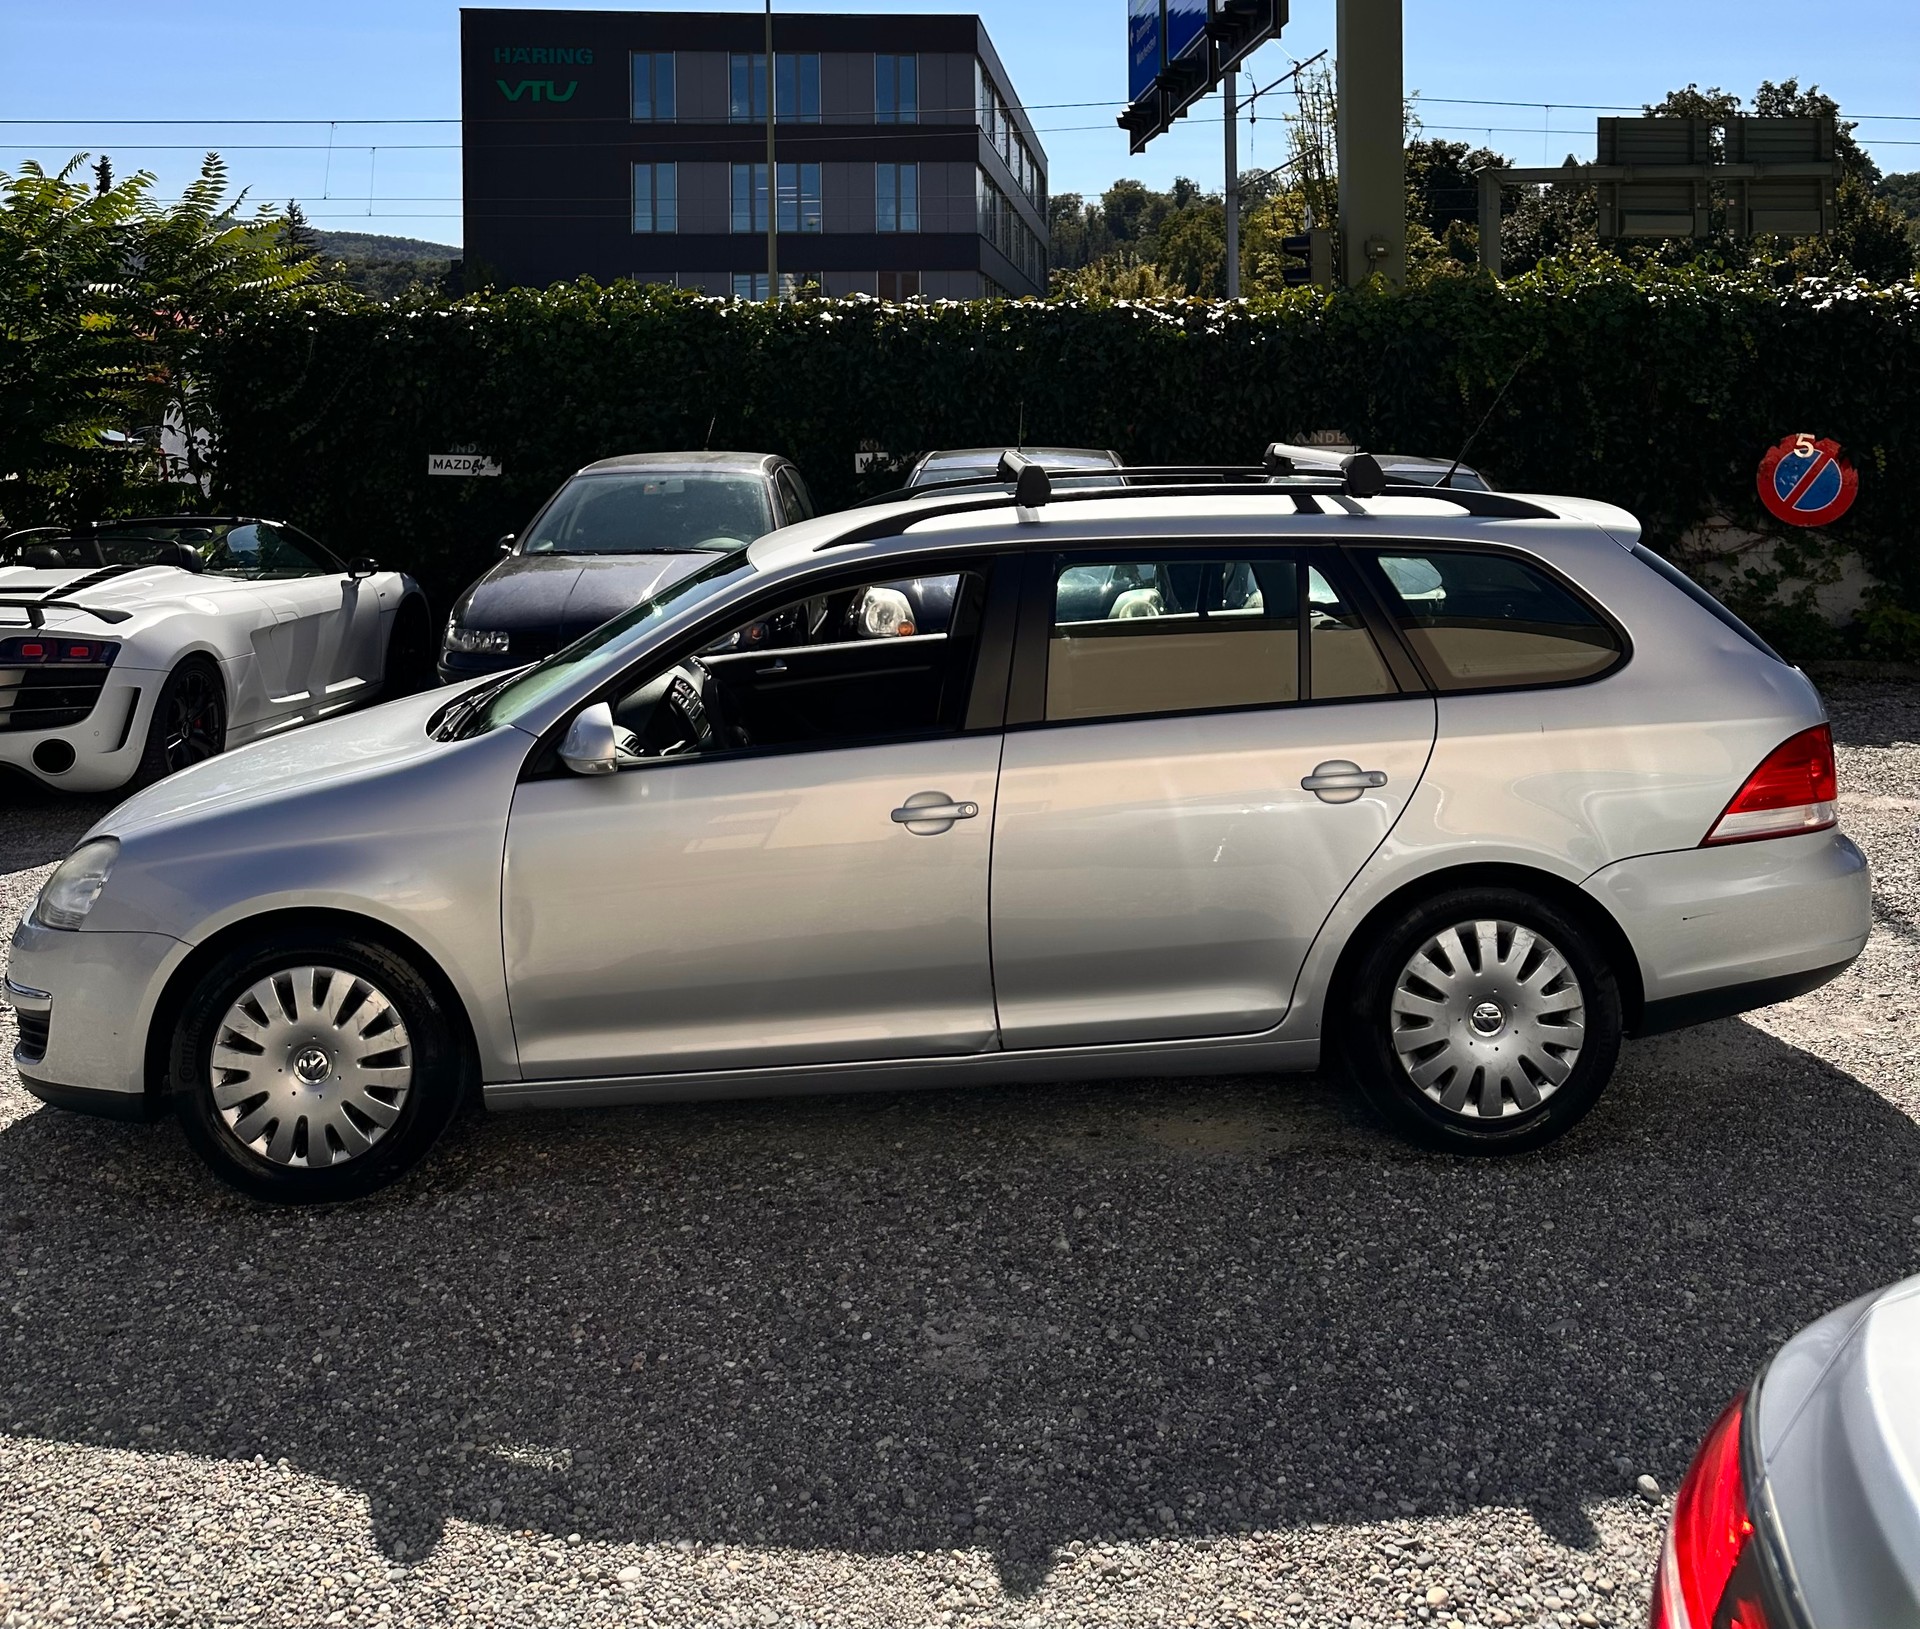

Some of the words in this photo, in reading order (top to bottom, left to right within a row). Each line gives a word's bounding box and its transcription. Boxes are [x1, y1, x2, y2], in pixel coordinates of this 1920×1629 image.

[493, 47, 593, 64] HÄRING
[496, 79, 578, 102] VTU
[1793, 432, 1816, 458] 5
